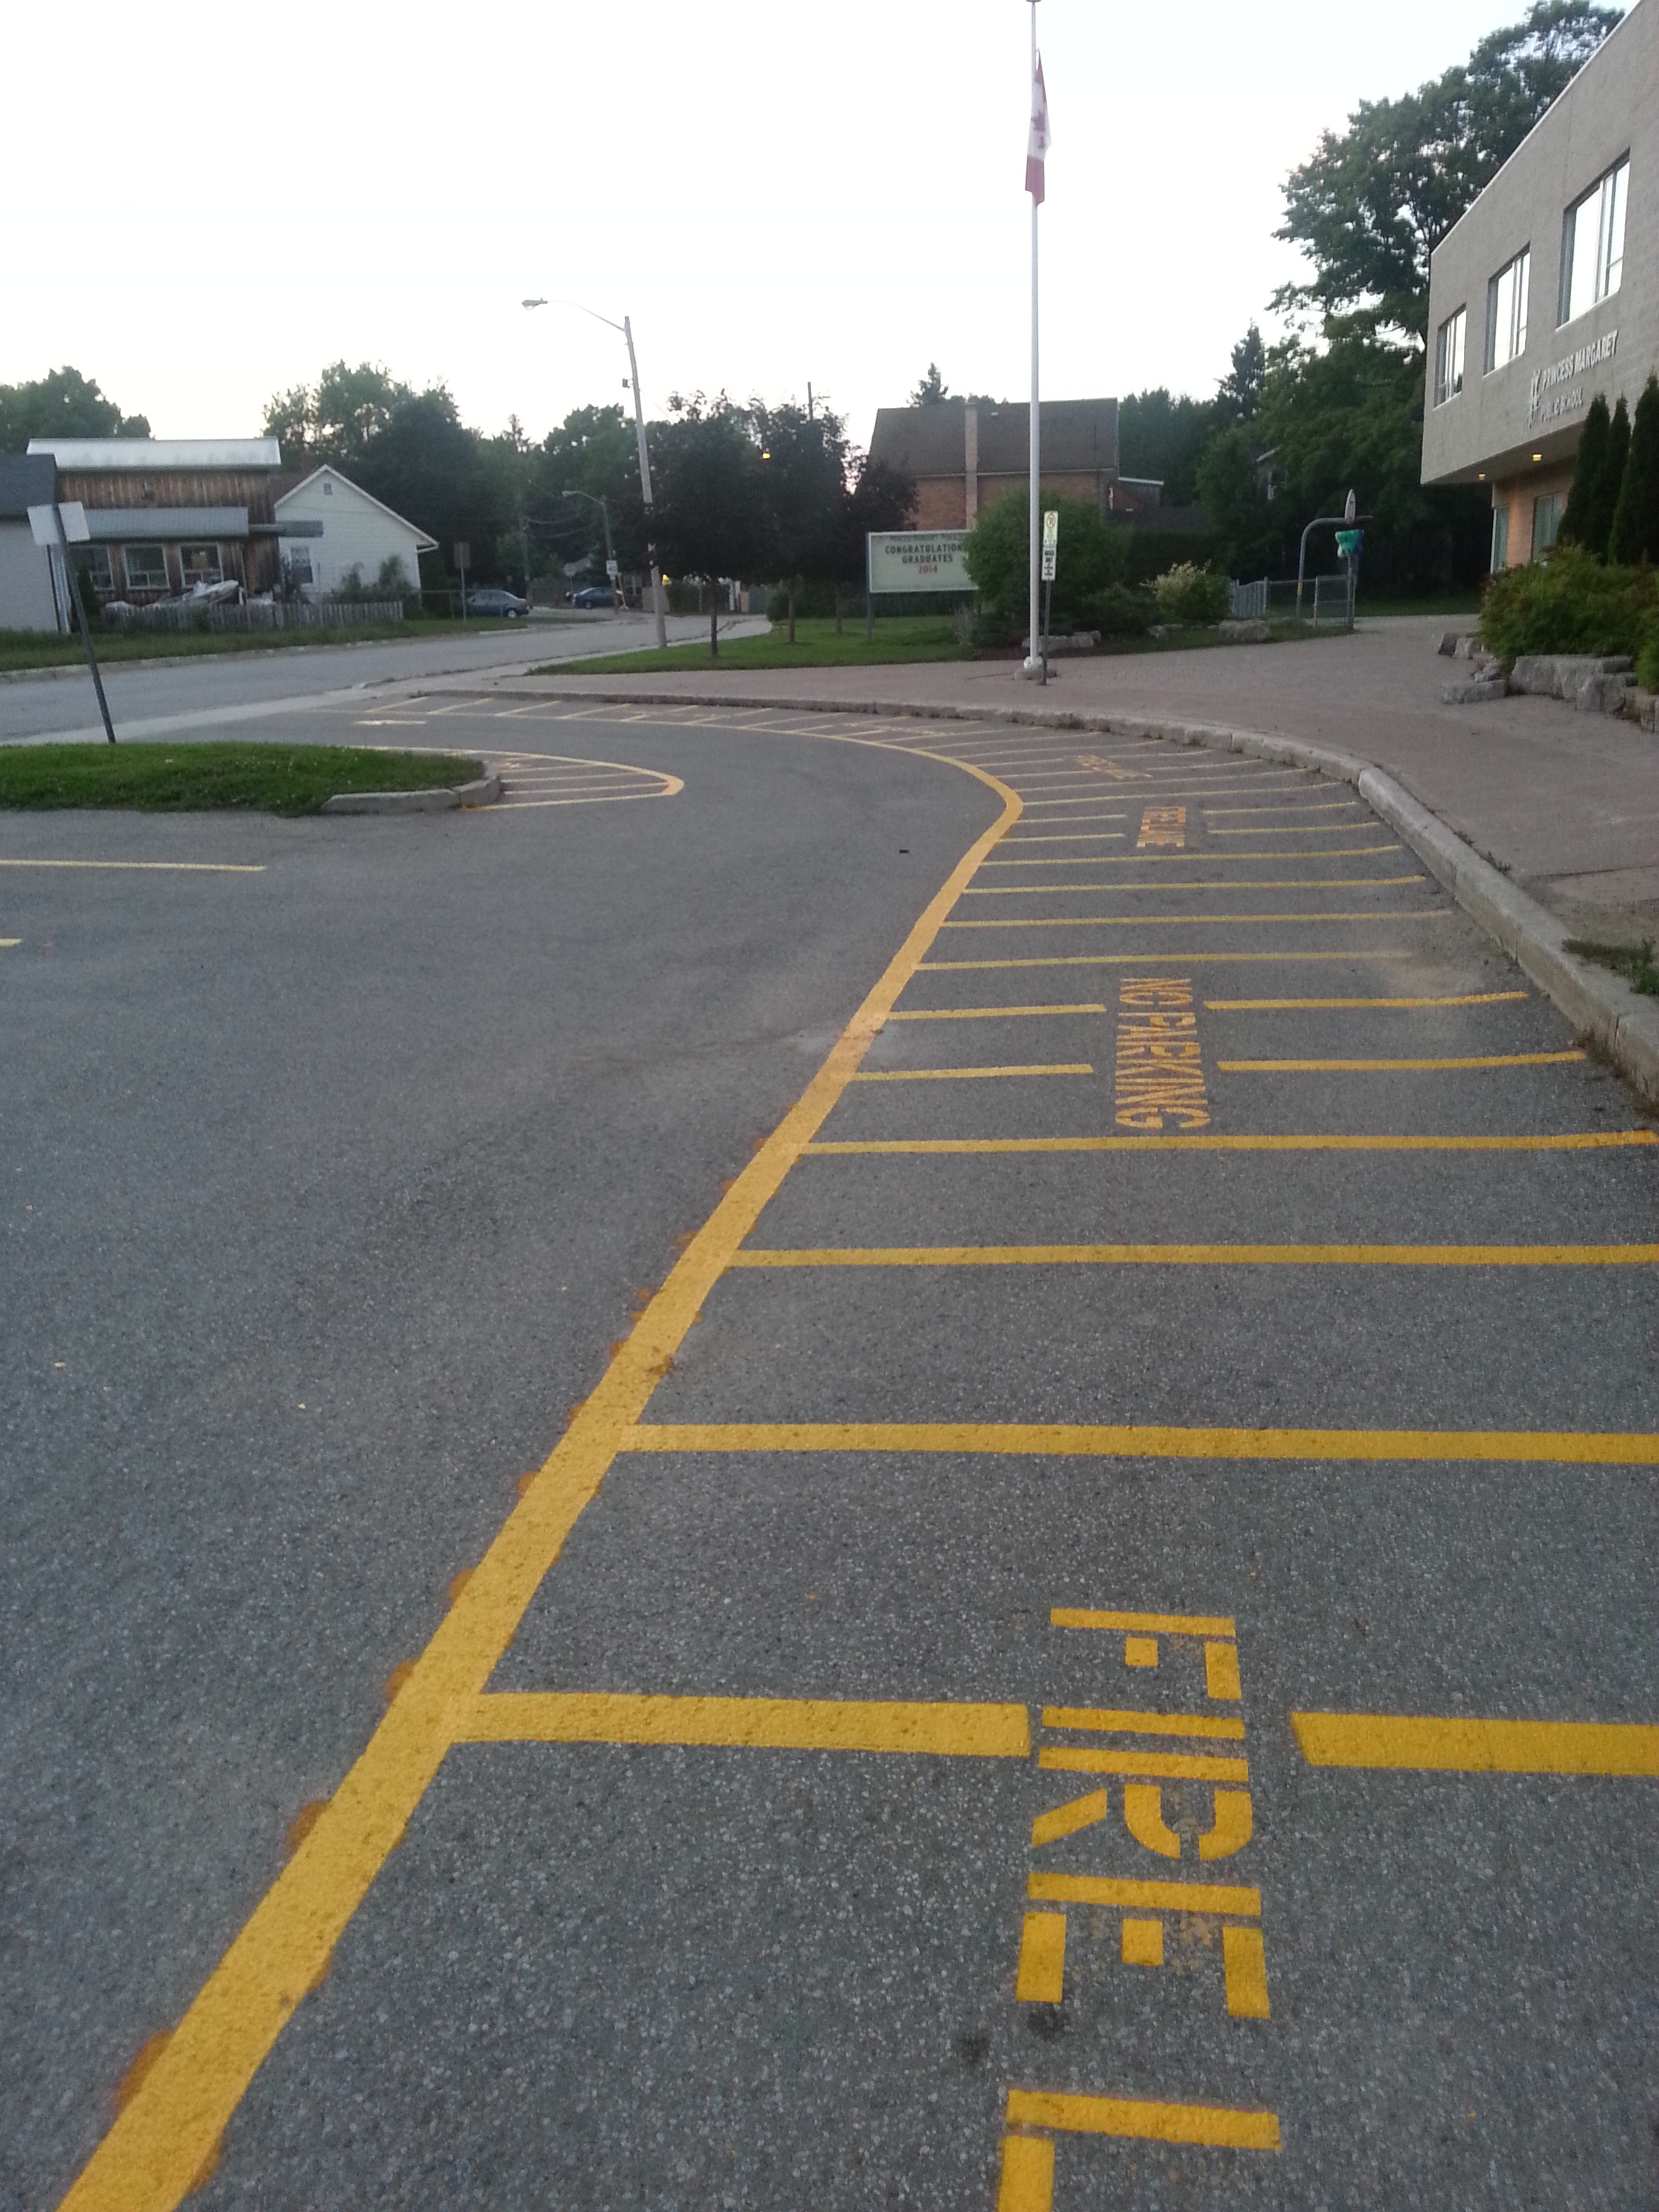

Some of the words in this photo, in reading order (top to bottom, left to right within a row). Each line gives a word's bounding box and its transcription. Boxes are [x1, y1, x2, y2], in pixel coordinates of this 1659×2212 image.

[1542, 354, 1575, 392] PRINCESS
[1575, 329, 1618, 374] MARGARET
[885, 543, 968, 554] CONGRATULATION
[902, 554, 953, 564] GRADUATES
[918, 565, 938, 573] 2014
[1119, 978, 1193, 1006] NO
[1115, 1012, 1210, 1129] PARKING
[1016, 1608, 1272, 2020] FIRE
